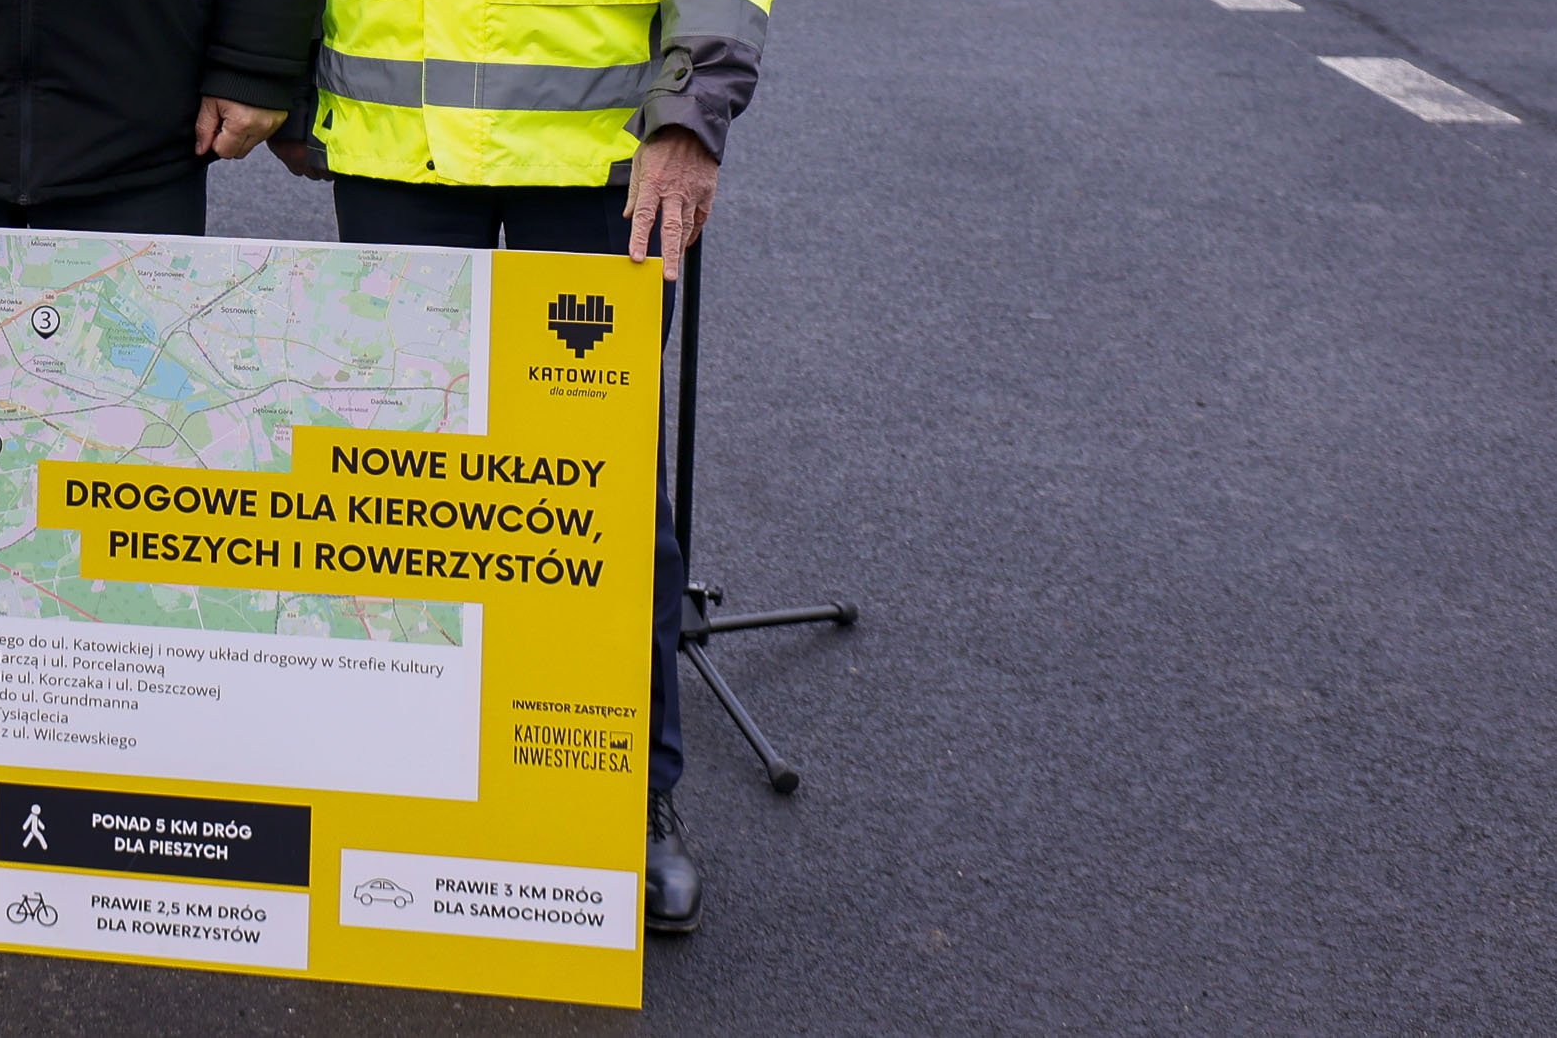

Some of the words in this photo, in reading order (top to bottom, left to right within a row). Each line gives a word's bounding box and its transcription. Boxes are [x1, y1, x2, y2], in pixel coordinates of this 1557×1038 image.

[40, 310, 52, 330] 3
[220, 306, 258, 315] Sosnowiec
[529, 366, 630, 386] KATOWICE
[549, 386, 564, 396] dla
[566, 387, 608, 400] odmiany
[332, 446, 447, 479] NOWE
[461, 453, 606, 488] UKŁADY
[66, 480, 257, 517] DROGOWE
[271, 491, 336, 522] DLA
[349, 496, 602, 544] KIEROWCÓW,
[110, 530, 279, 567] PIESZYCH
[294, 541, 301, 568] I
[315, 545, 603, 587] ROWERZYSTÓW
[29, 635, 47, 648] do
[52, 636, 68, 650] ul.
[74, 638, 153, 659] Katowickiej
[158, 644, 161, 656] i
[166, 647, 205, 662] nowy
[209, 647, 249, 662] układ
[253, 650, 317, 670] drogowy
[321, 658, 334, 668] w
[339, 656, 386, 671] Strefie
[391, 659, 444, 678] Kultury
[43, 654, 46, 667] i
[51, 655, 67, 668] ul.
[73, 656, 165, 678] Porcelanową
[0, 687, 17, 701] do
[22, 689, 38, 703] ul.
[43, 692, 138, 710] Grundmanna
[18, 671, 34, 684] ul.
[39, 673, 103, 689] Korczaka
[108, 678, 111, 690] i
[116, 678, 132, 692] ul.
[138, 680, 220, 701] Deszczowej
[512, 699, 571, 713] INWESTOR
[574, 703, 637, 719] ZASTĘPCZY
[1, 728, 8, 738] z
[13, 726, 29, 739] ul.
[34, 728, 137, 750] Wilczewskiego
[514, 723, 608, 749] KATOWICKIE
[513, 745, 606, 771] INWESTYCJE
[608, 752, 633, 774] S.A.
[91, 812, 152, 832] PONAD
[155, 818, 166, 833] 5
[170, 820, 198, 837] KM
[202, 819, 253, 840] DRÓG
[114, 836, 145, 853] DLA
[149, 839, 229, 861] PIESZYCH
[435, 877, 499, 896] PRAWIE
[503, 882, 513, 897] 3
[519, 885, 546, 900] KM
[552, 885, 604, 904] DRÓG
[90, 894, 152, 913] PRAWIE
[156, 900, 181, 916] 2,5
[185, 903, 213, 918] KM
[217, 904, 267, 923] DRÓG
[433, 900, 465, 916] DLA
[469, 902, 605, 927] SAMOCHODÓW
[96, 917, 127, 933] DLA
[131, 920, 261, 944] ROWERZYSTÓW
